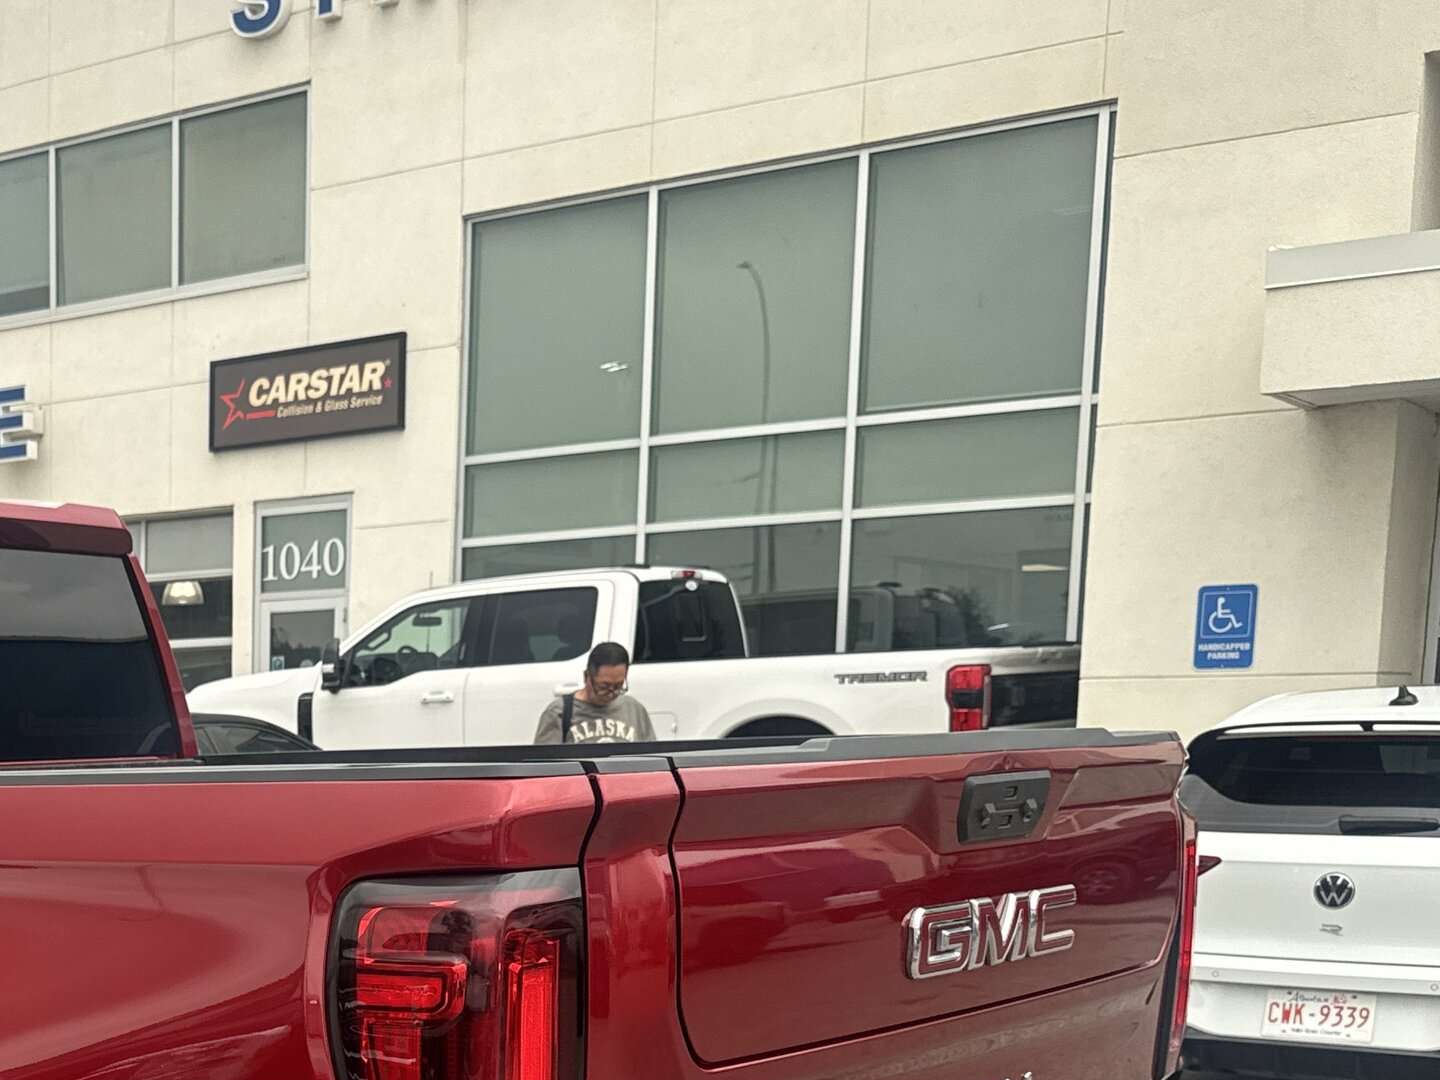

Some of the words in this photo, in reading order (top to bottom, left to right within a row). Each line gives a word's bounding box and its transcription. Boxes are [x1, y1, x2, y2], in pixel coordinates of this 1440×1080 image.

[249, 362, 386, 407] CARSTAR
[276, 404, 314, 418] Collision
[315, 400, 323, 413] &
[324, 398, 349, 412] Glass
[350, 394, 384, 409] Service
[262, 537, 345, 581] 1040
[1207, 651, 1241, 660] PARKING
[833, 670, 928, 685] TREMOR
[570, 718, 636, 743] ALASKA
[907, 883, 1077, 980] GMC
[1267, 1001, 1371, 1028] CWK-9339
